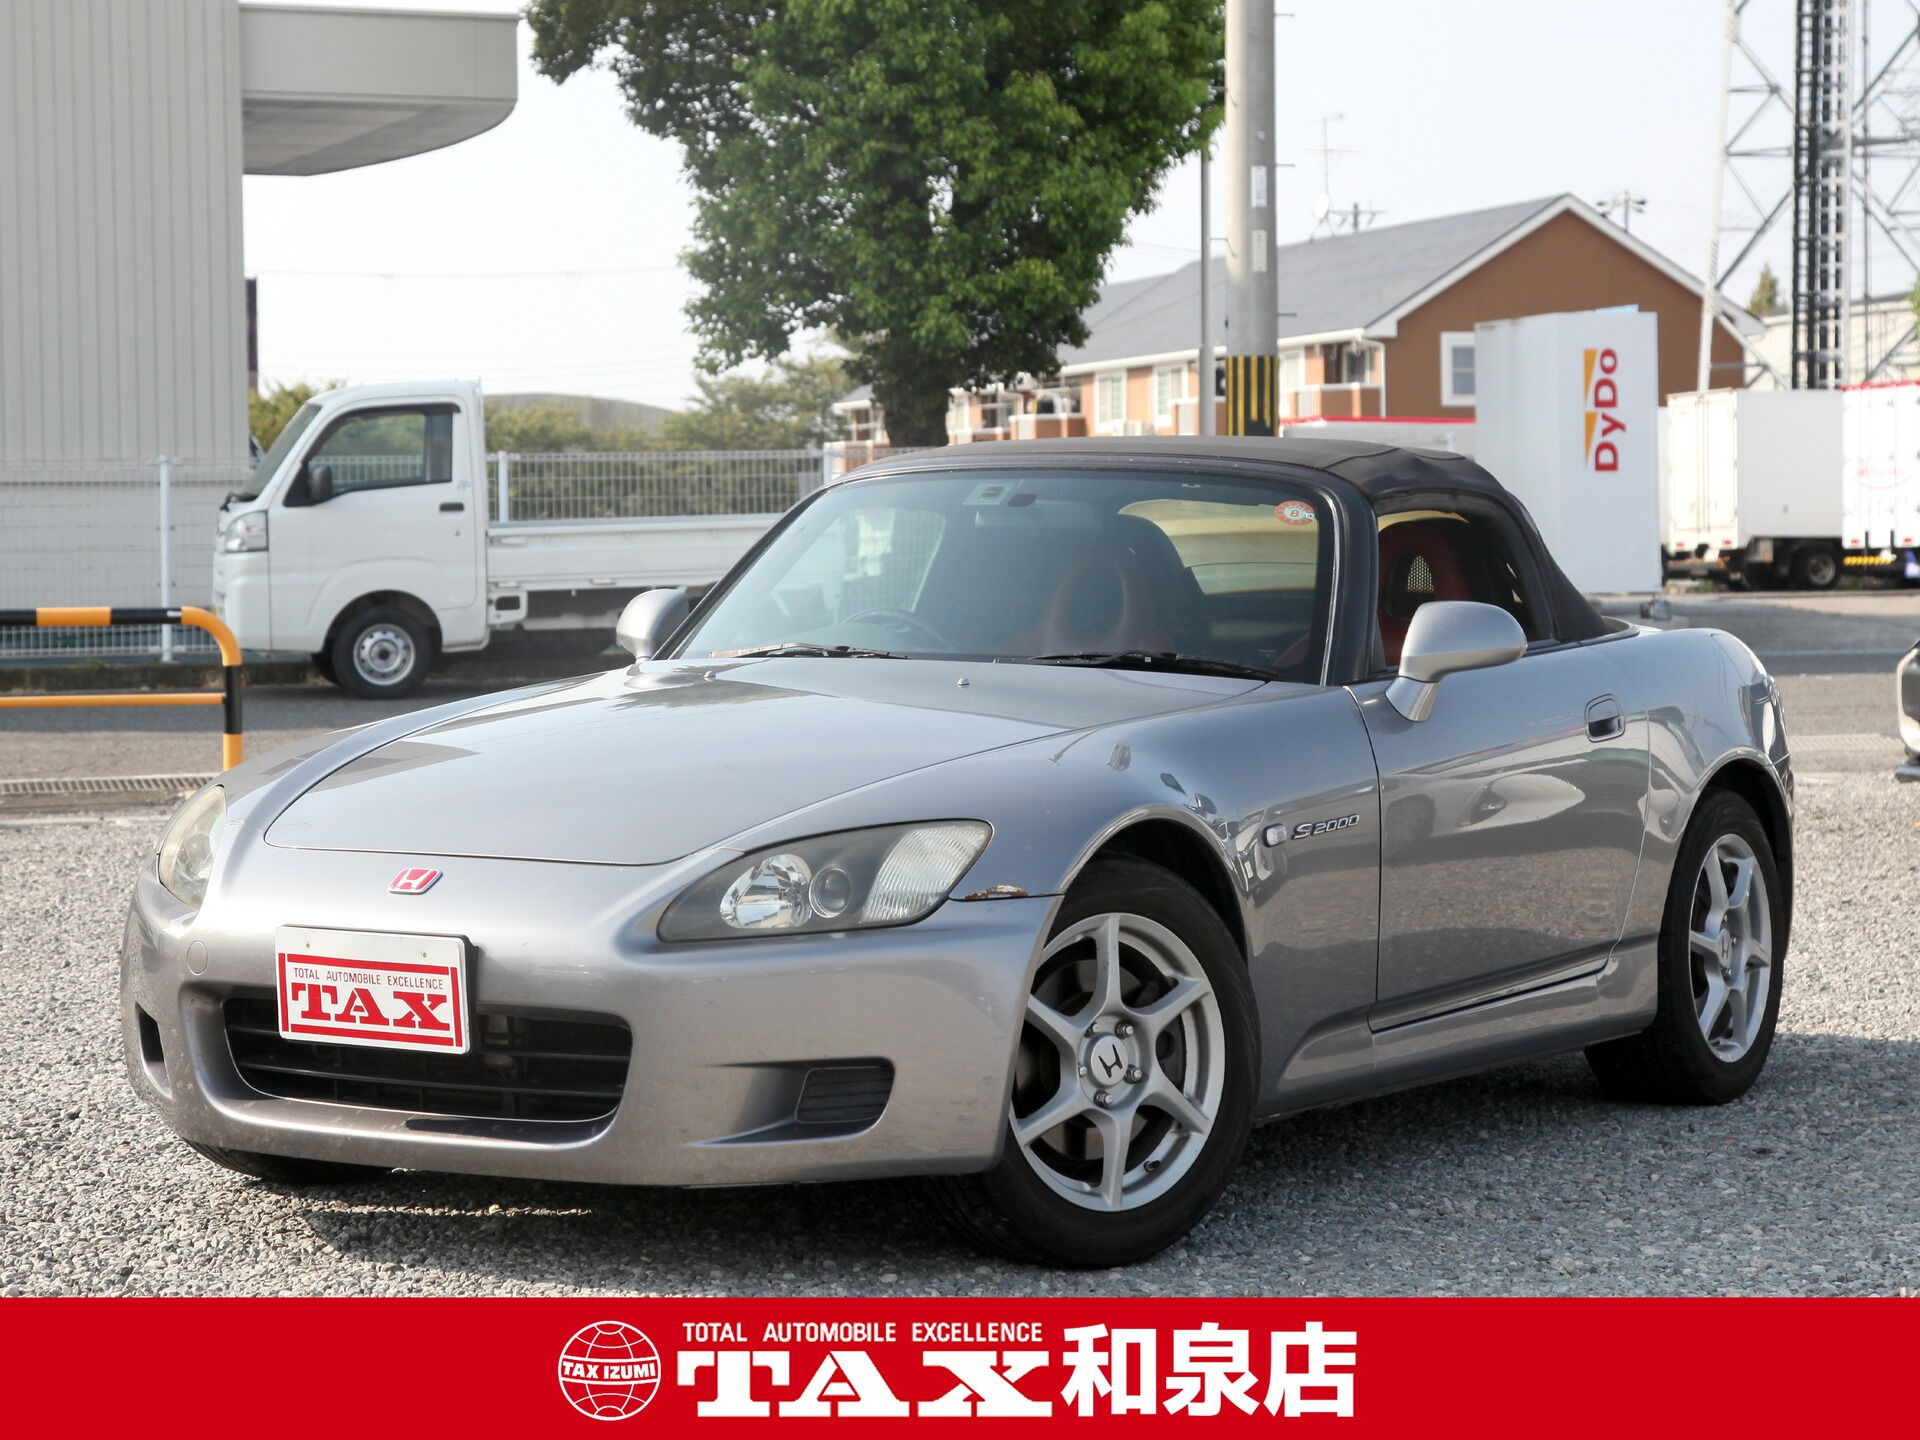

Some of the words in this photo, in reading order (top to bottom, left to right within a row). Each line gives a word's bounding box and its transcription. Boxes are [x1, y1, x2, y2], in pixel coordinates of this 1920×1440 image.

[1594, 348, 1626, 472] DyDo
[1291, 814, 1360, 840] S2000
[294, 967, 320, 980] TOTAL
[326, 971, 381, 985] AUTOMOBILE
[387, 976, 444, 990] EXCELLENCE
[291, 982, 450, 1031] TAX
